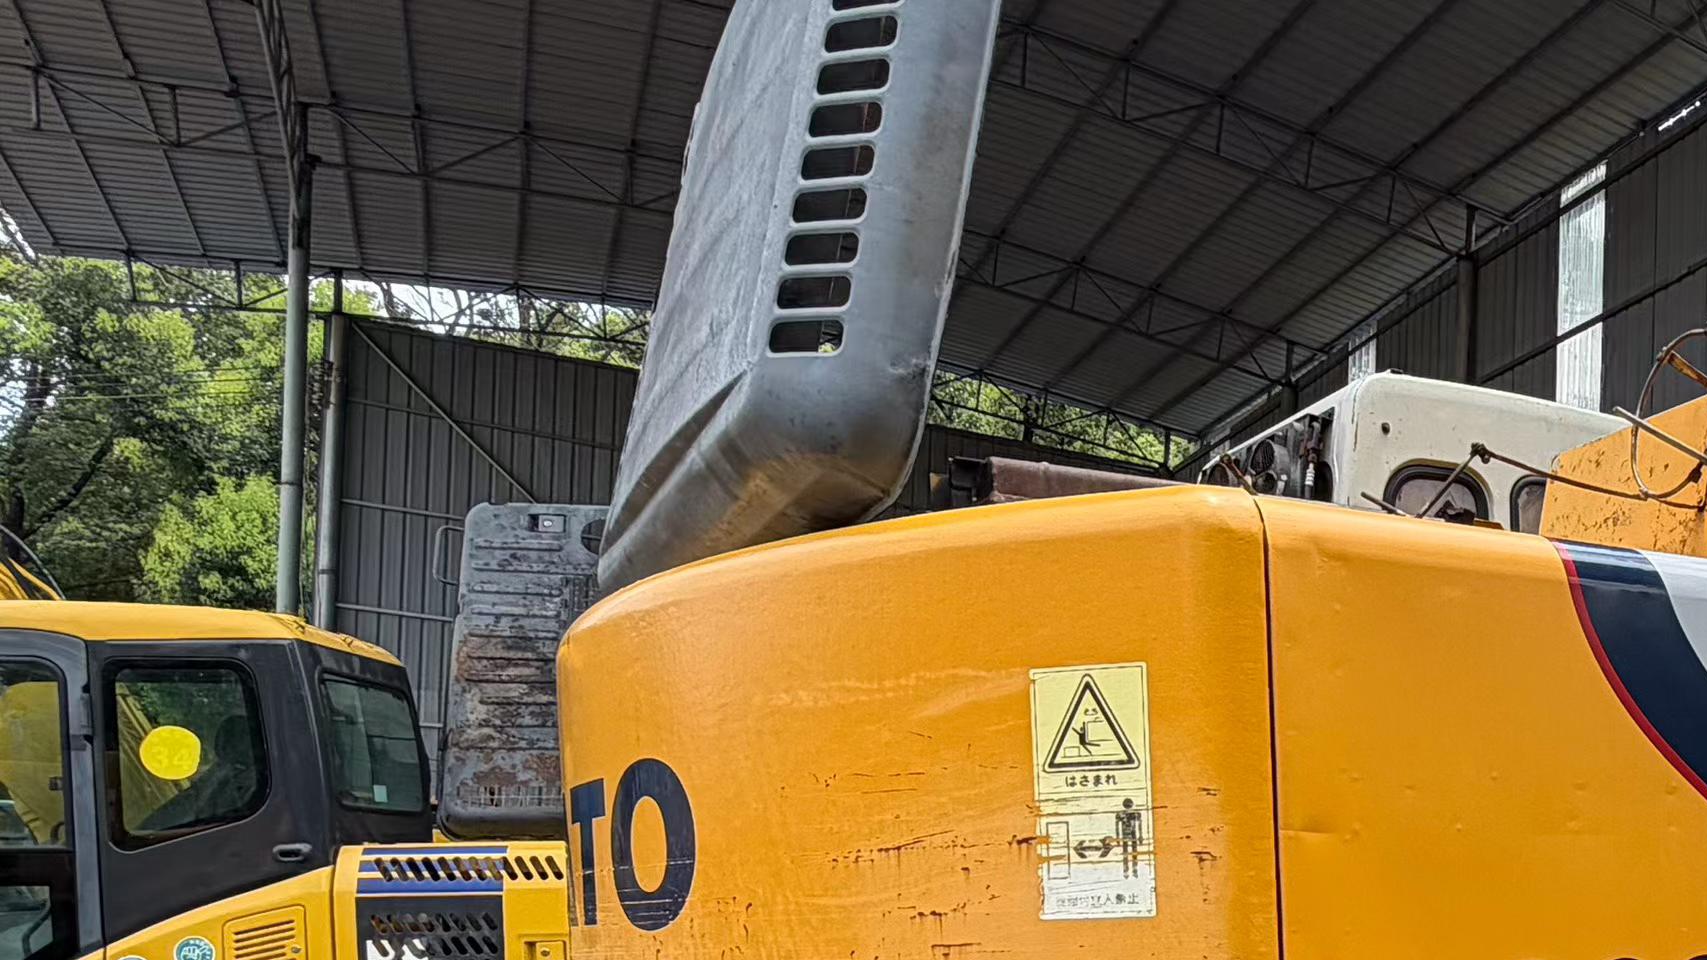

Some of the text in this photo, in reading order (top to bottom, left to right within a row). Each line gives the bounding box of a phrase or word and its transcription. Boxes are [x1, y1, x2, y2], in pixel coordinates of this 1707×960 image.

[1065, 774, 1118, 788] はさまれ
[562, 758, 696, 932] TO
